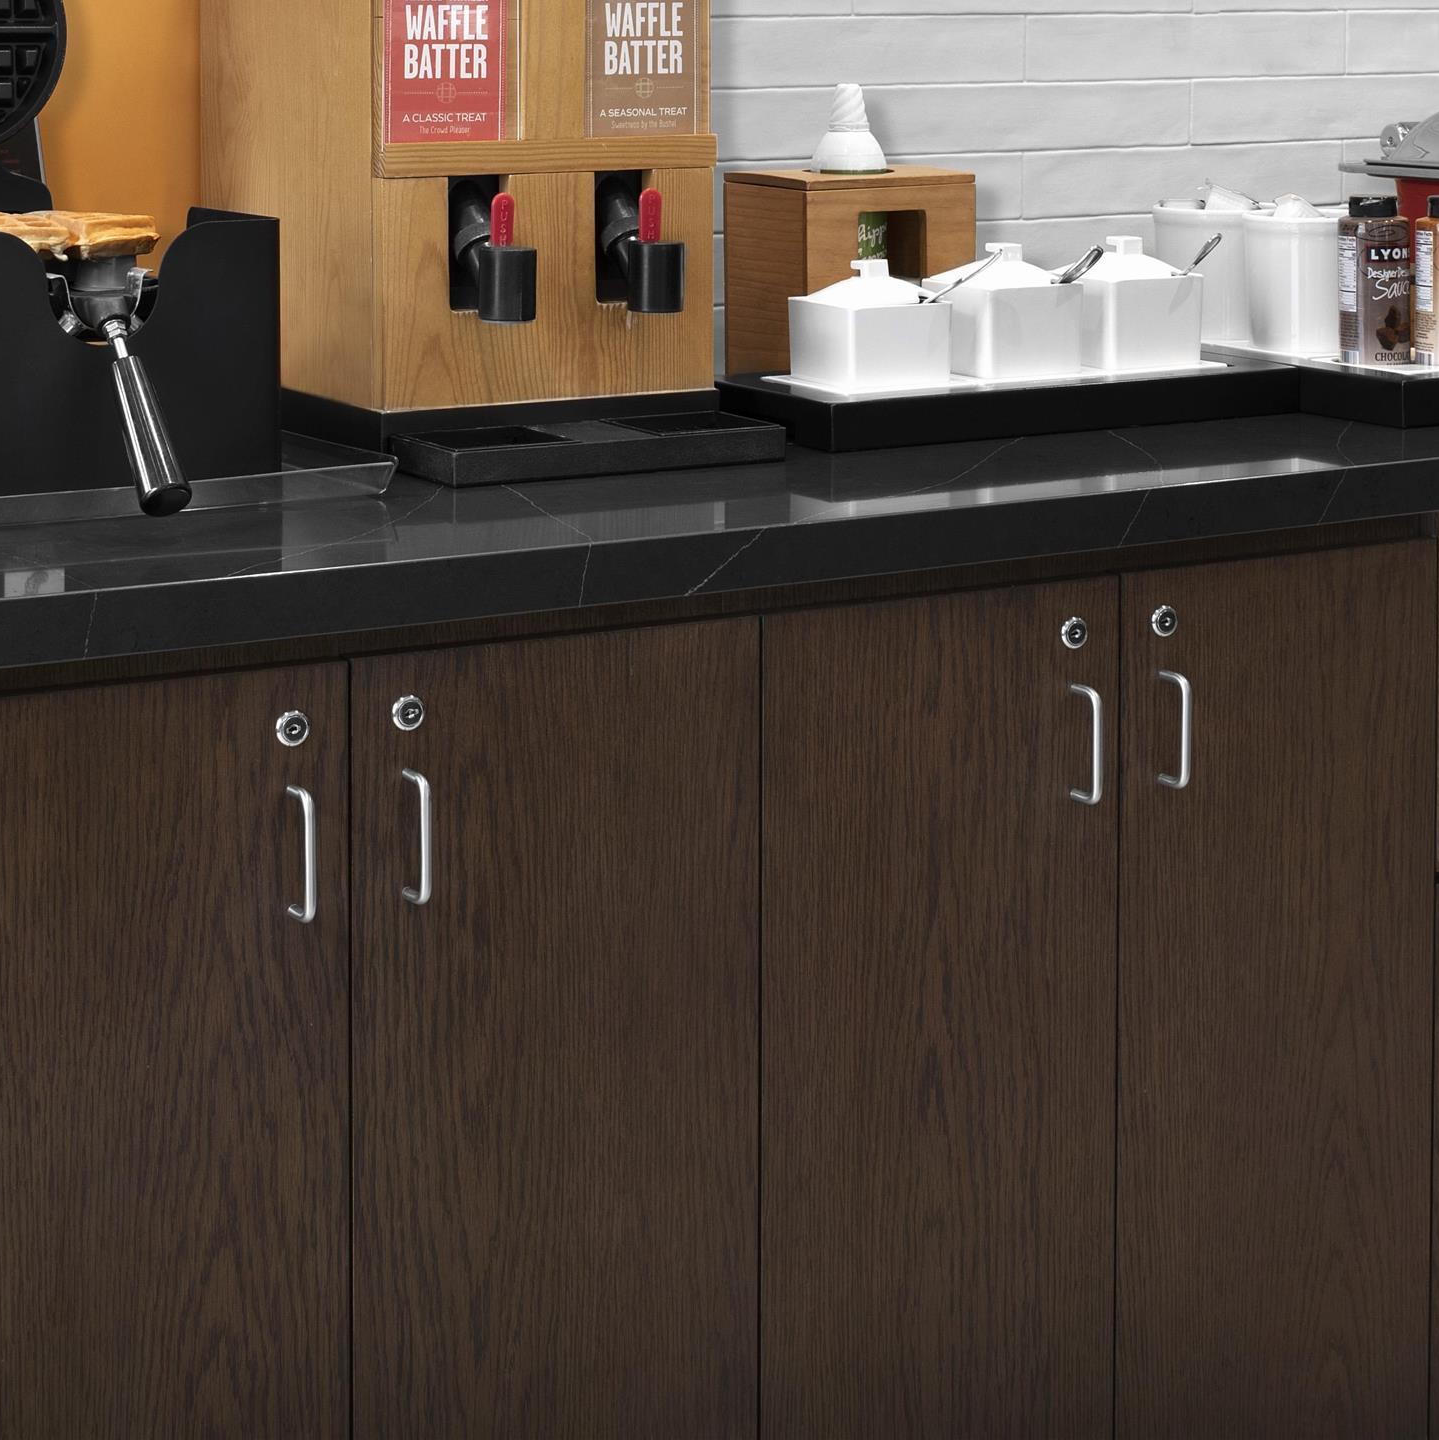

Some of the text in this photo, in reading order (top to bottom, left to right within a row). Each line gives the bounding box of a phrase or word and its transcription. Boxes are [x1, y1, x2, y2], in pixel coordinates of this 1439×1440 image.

[405, 4, 488, 40] WAFFLE
[605, 2, 683, 37] WAFFLE
[404, 43, 487, 79] BATTER
[604, 40, 683, 75] BATTER
[402, 112, 487, 122] A CLASSIC TREAT
[599, 107, 688, 117] A SEASONAL TREAT
[419, 126, 429, 134] The
[430, 126, 448, 134] Crowd
[499, 199, 508, 247] PUSH
